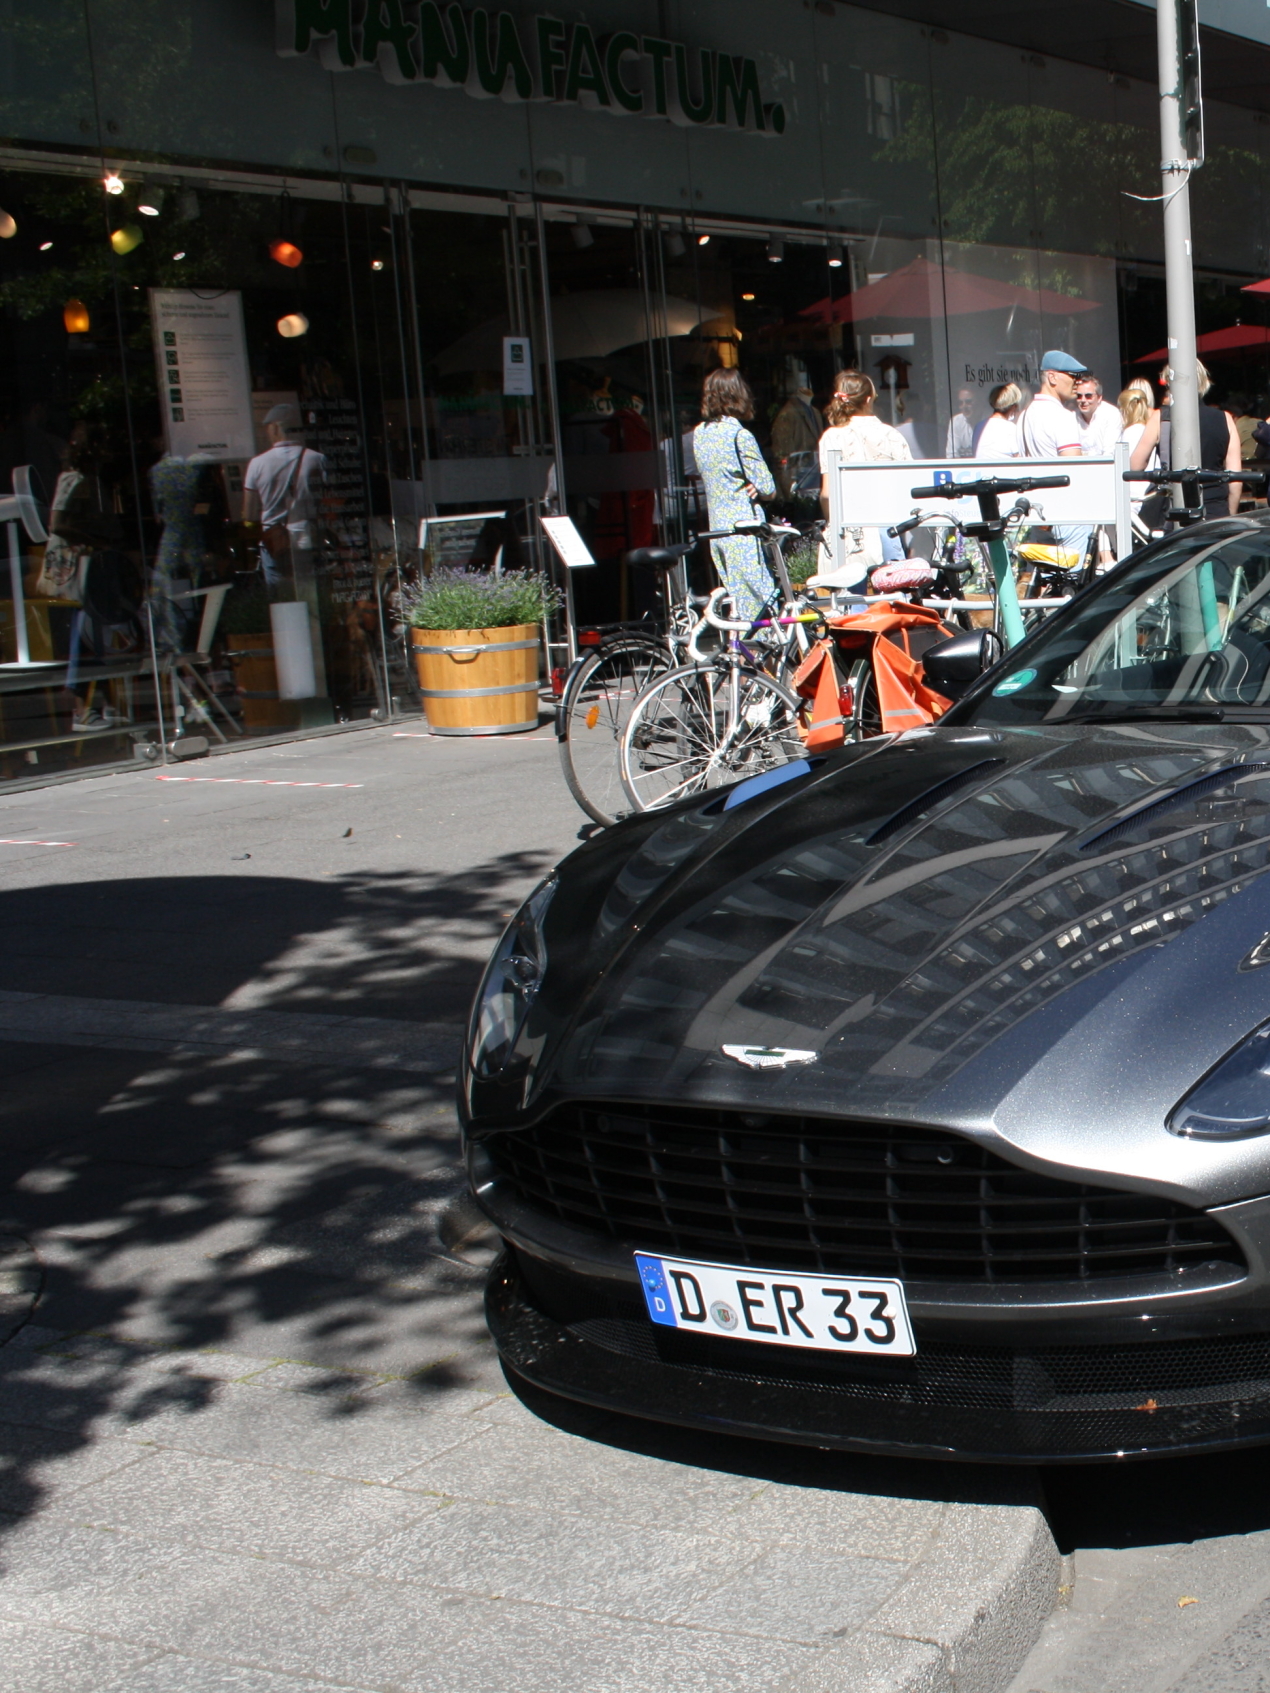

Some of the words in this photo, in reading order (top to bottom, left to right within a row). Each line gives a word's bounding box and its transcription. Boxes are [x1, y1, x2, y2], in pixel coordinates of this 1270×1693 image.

[965, 364, 976, 382] Es
[977, 363, 994, 387] gibt
[996, 365, 1008, 382] sie
[655, 1296, 667, 1312] D
[669, 1269, 708, 1323] D
[736, 1279, 815, 1339] ER
[821, 1287, 897, 1346] 33
